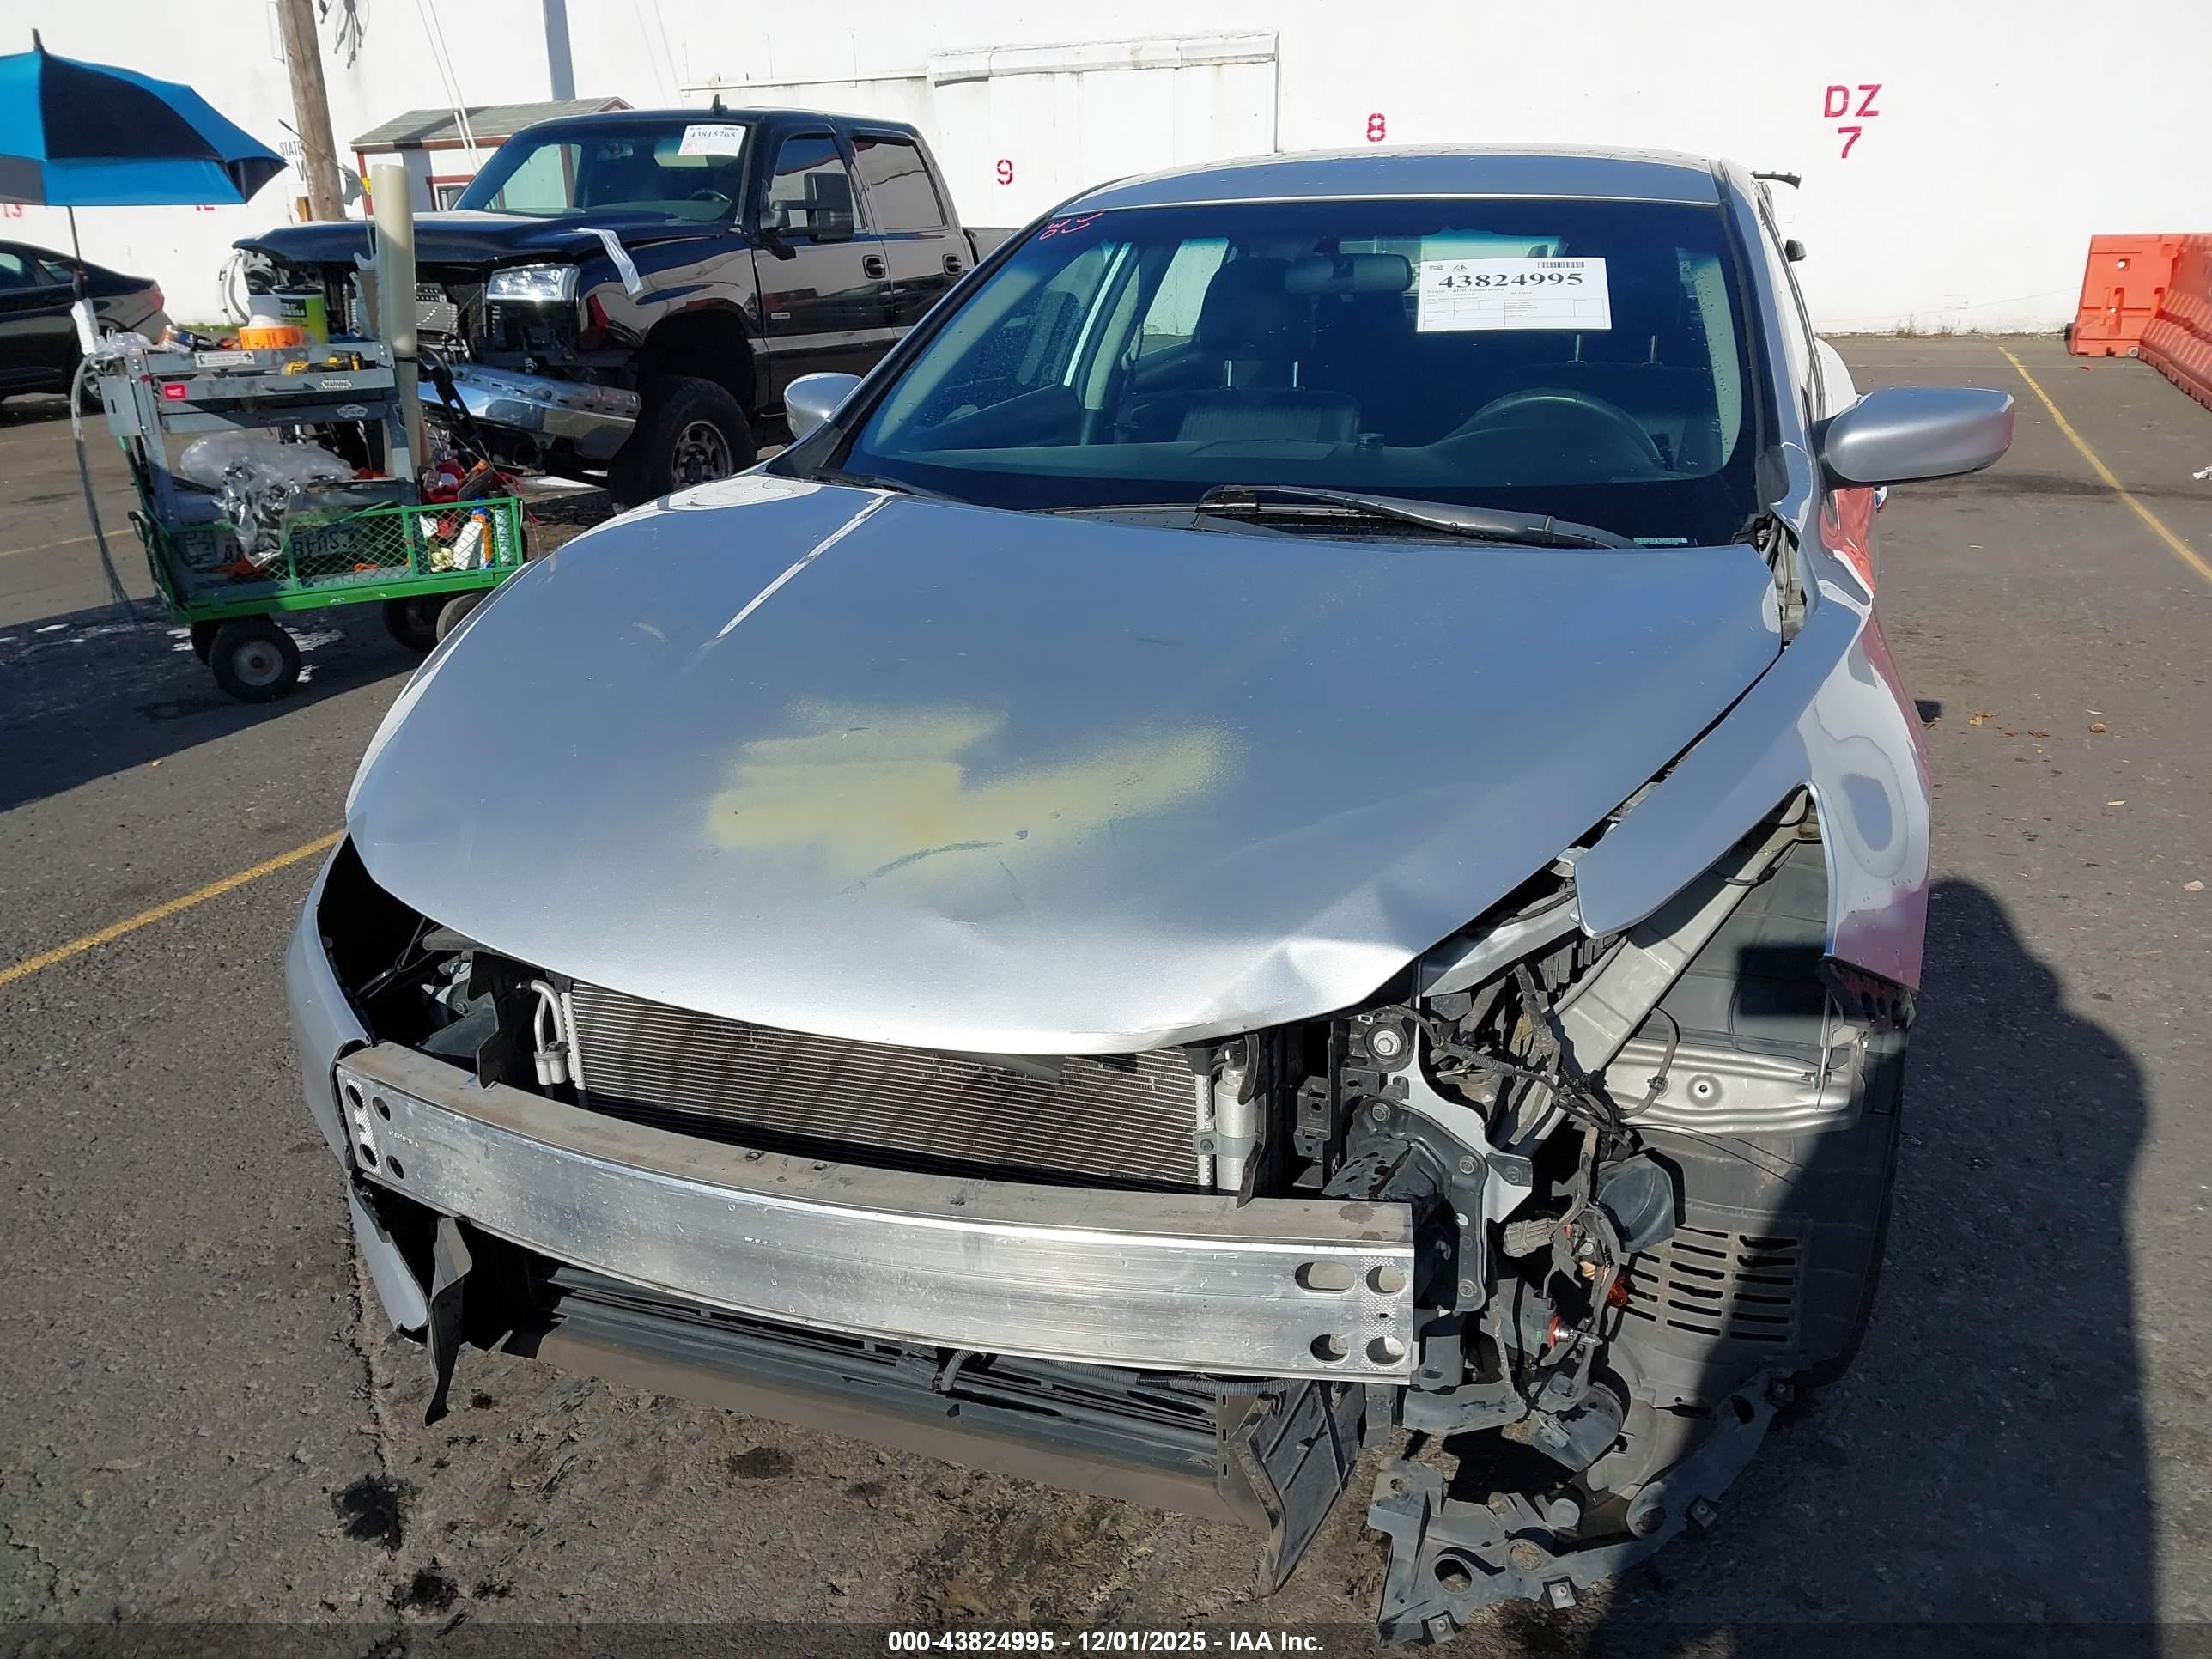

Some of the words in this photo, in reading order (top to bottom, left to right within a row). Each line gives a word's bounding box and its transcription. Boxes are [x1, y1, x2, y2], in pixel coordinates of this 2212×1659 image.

[1824, 83, 1883, 118] DZ
[1366, 112, 1387, 143] 8
[1838, 126, 1862, 159] 7
[996, 159, 1014, 185] 9
[1438, 272, 1583, 288] 43824995
